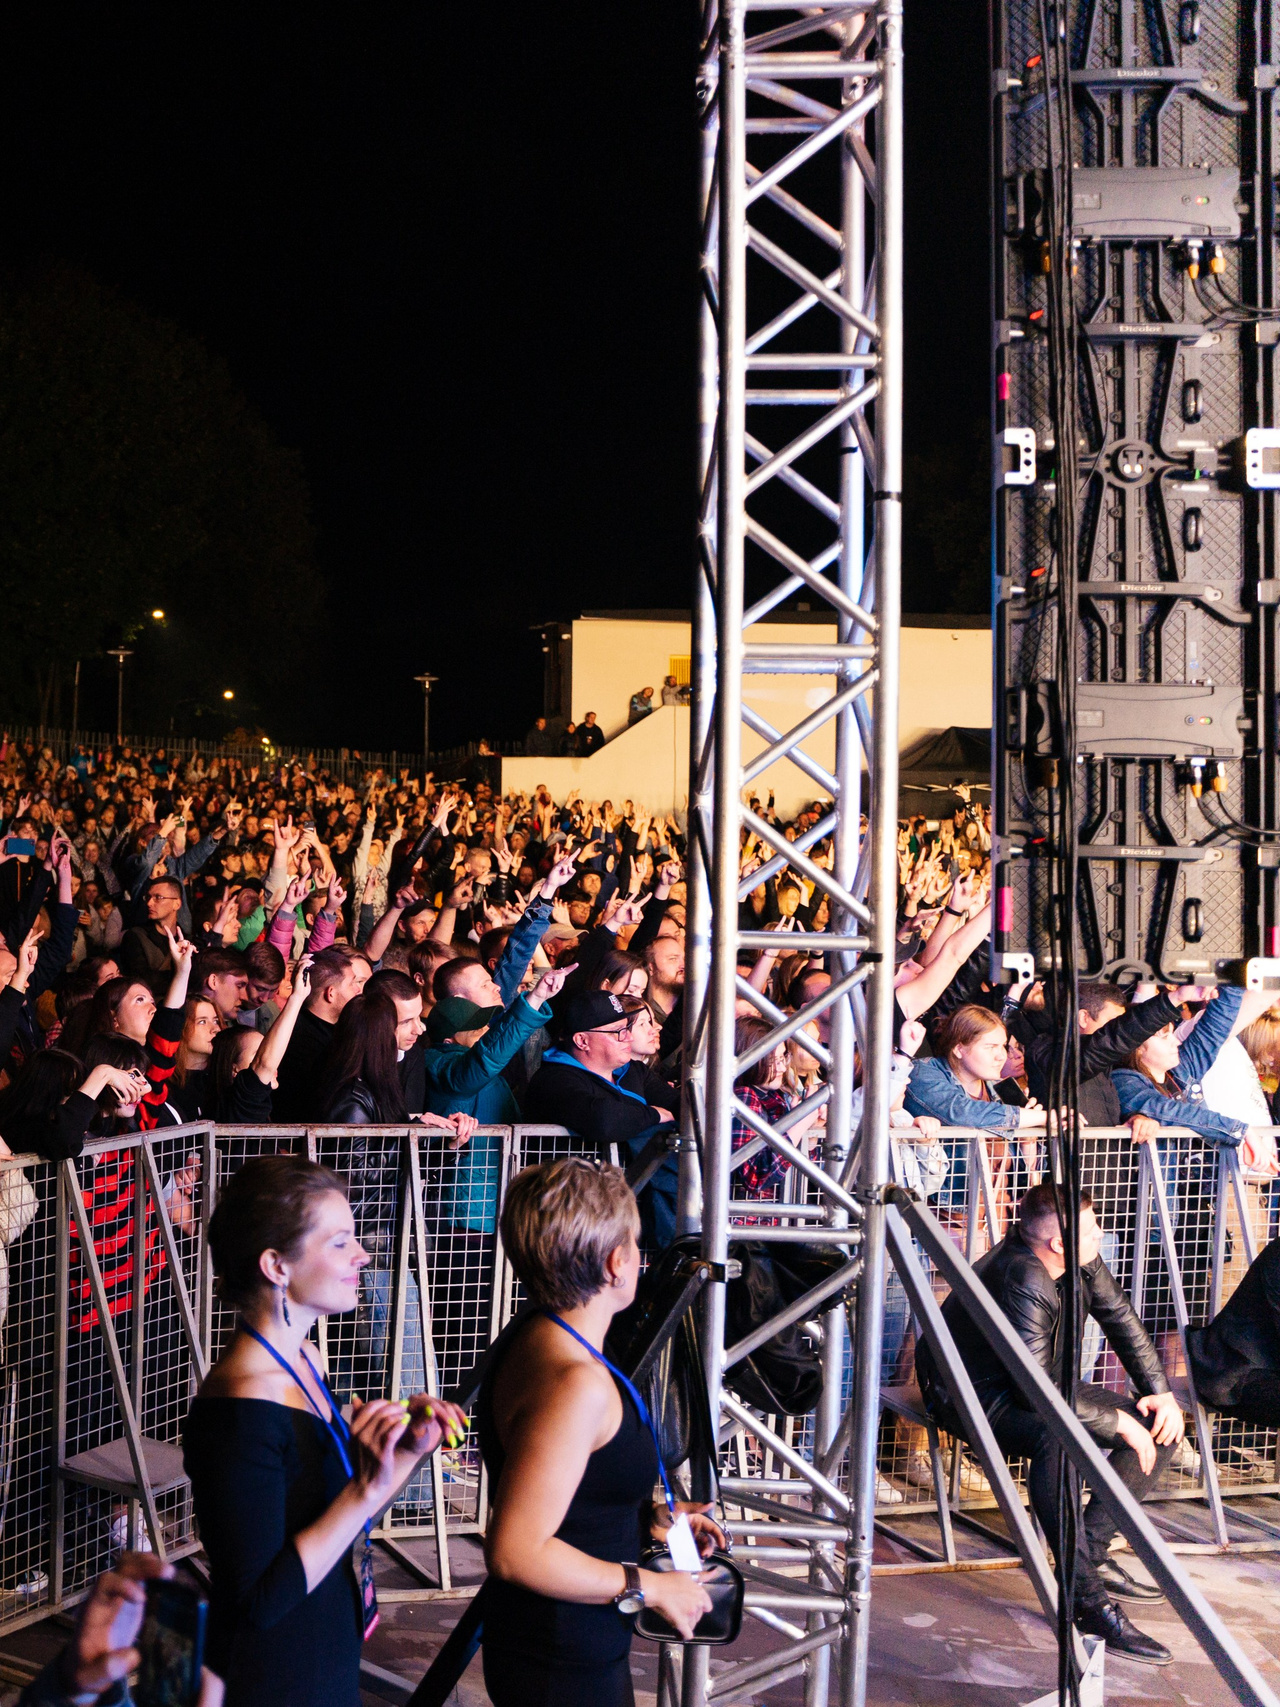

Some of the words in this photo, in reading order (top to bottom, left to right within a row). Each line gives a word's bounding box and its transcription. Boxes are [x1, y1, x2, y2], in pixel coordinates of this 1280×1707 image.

[1117, 69, 1160, 77] Dicolor
[1119, 324, 1162, 332] Dicolor
[1120, 584, 1164, 592] Dicolor
[1120, 848, 1164, 856] Dicolor
